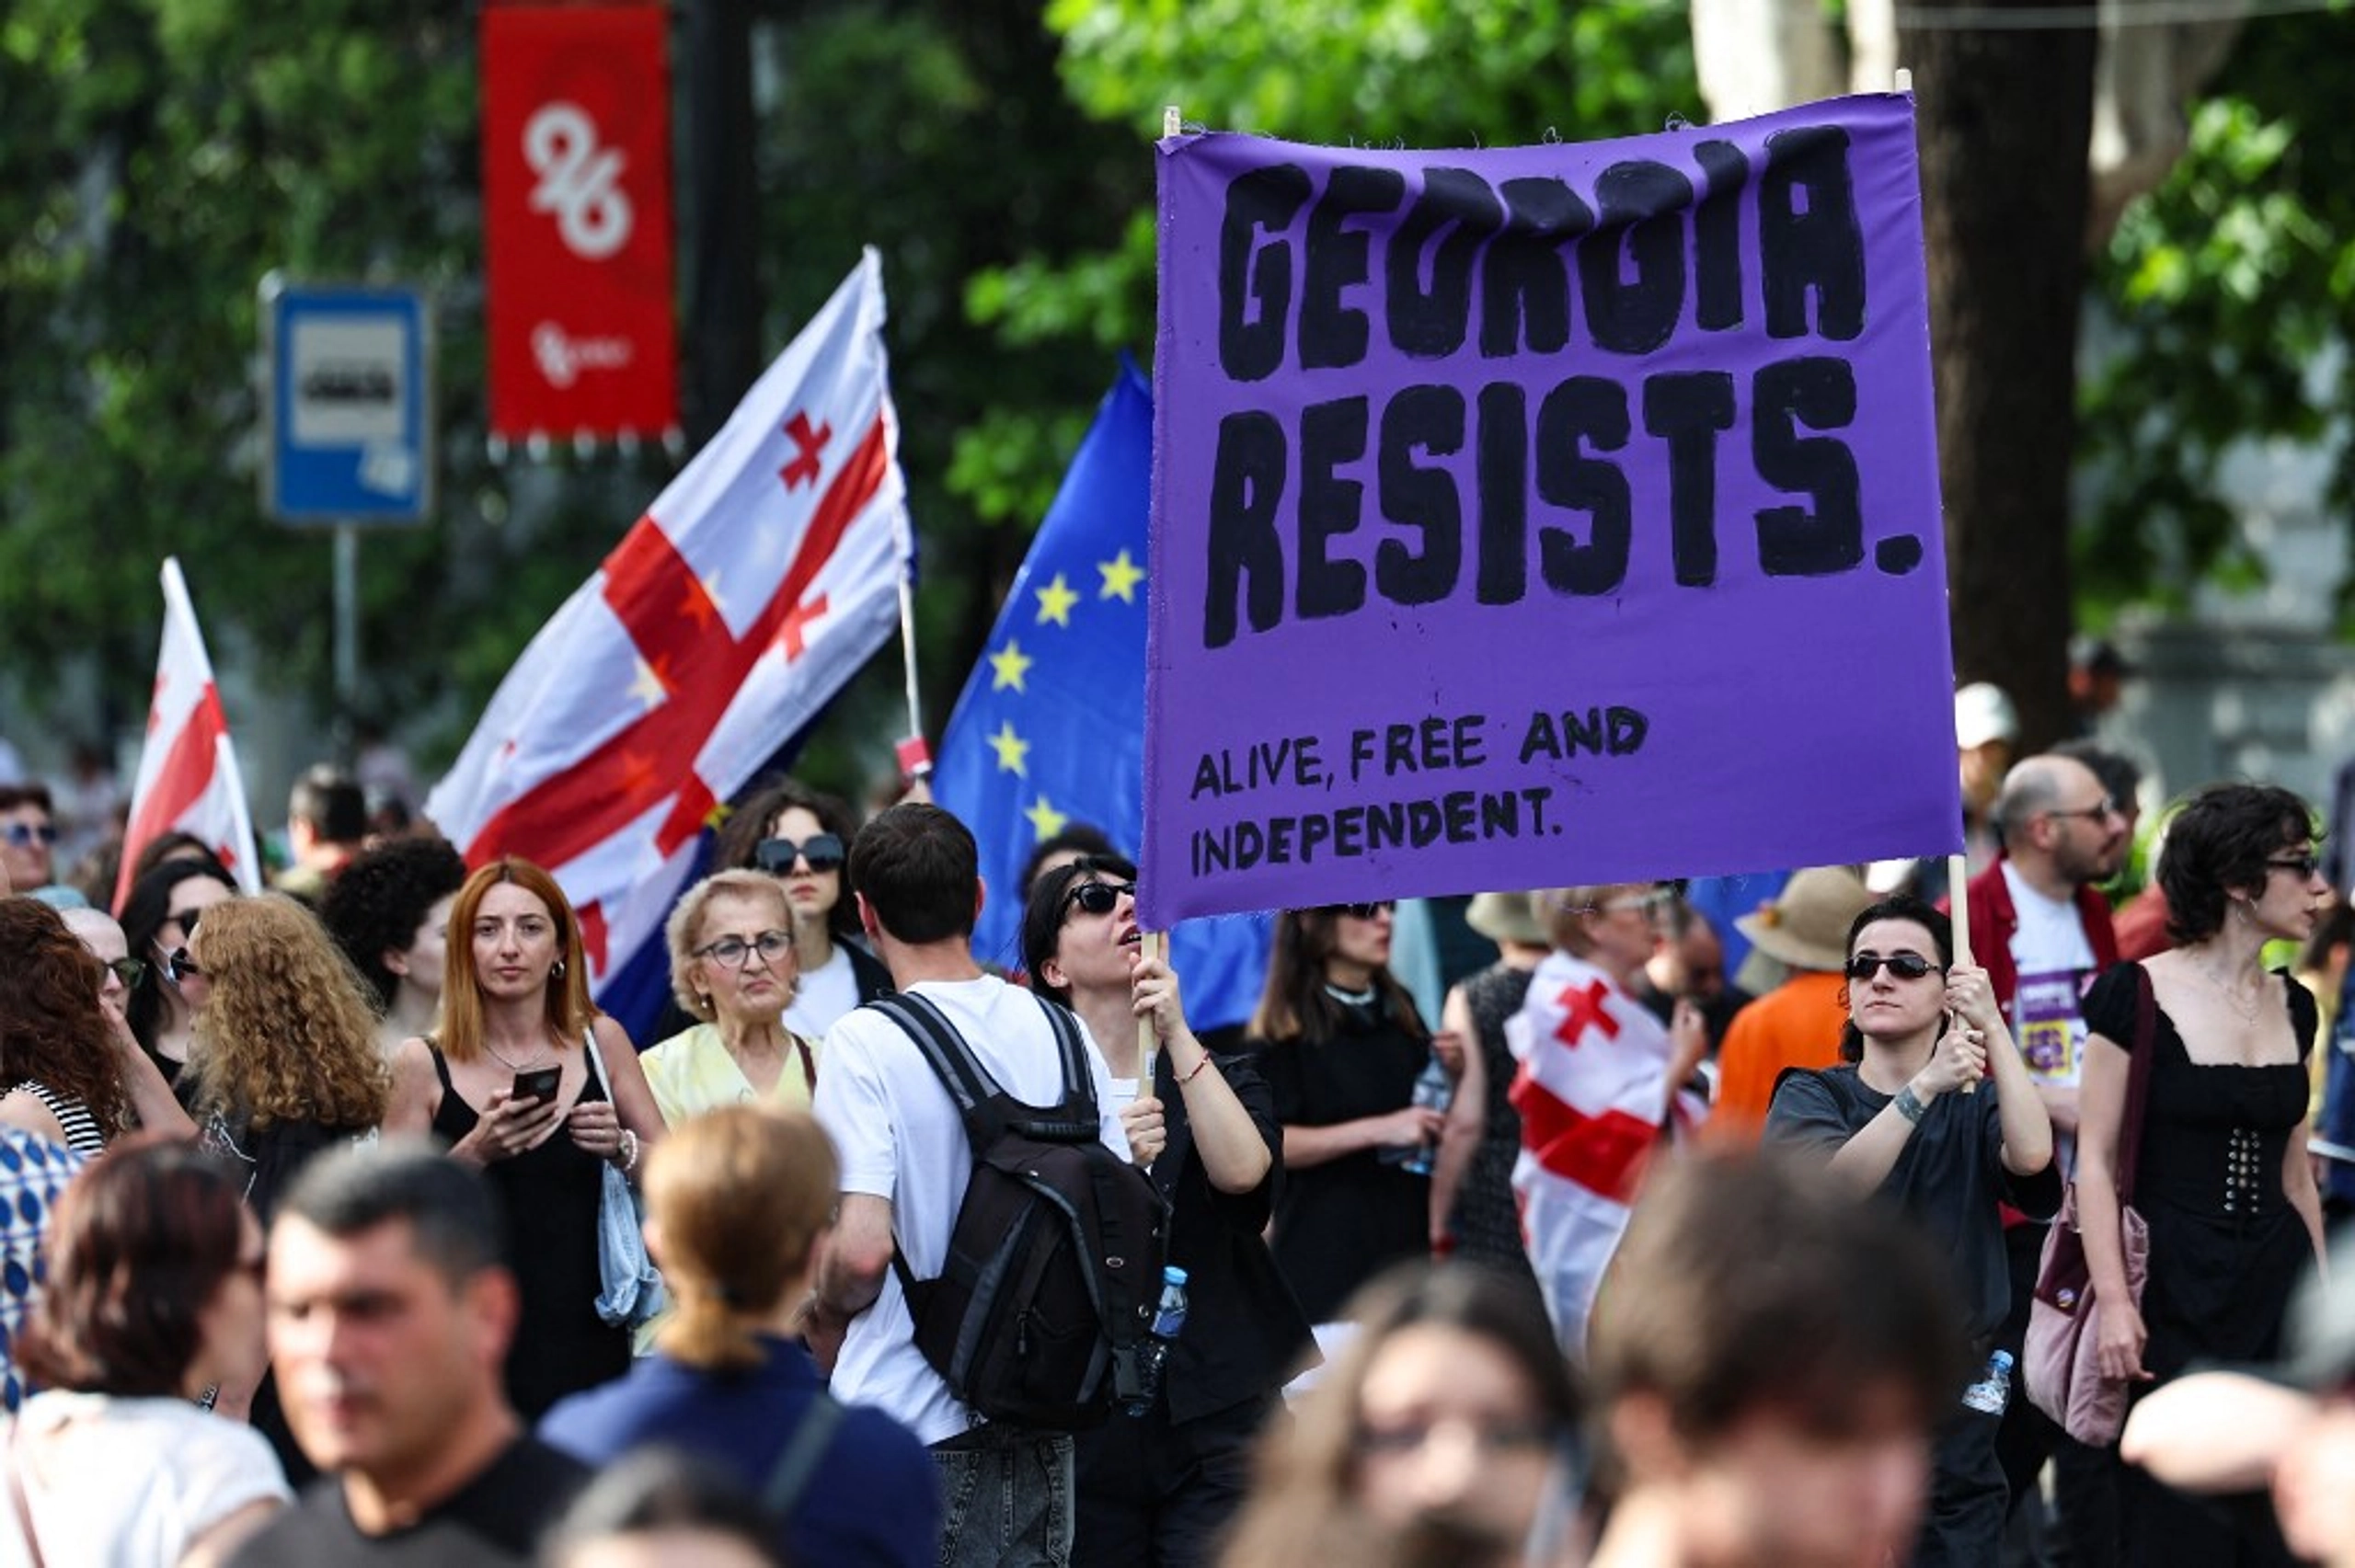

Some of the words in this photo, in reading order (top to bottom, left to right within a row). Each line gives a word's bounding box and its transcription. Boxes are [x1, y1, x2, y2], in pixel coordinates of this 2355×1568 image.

[1218, 125, 1867, 382] GEORGIA
[1203, 356, 1923, 649] RESISTS.
[1190, 736, 1336, 800] ALIVE,
[1350, 715, 1488, 781] FREE
[1519, 705, 1649, 764] AND
[1191, 786, 1563, 876] INDEPENDENT.
